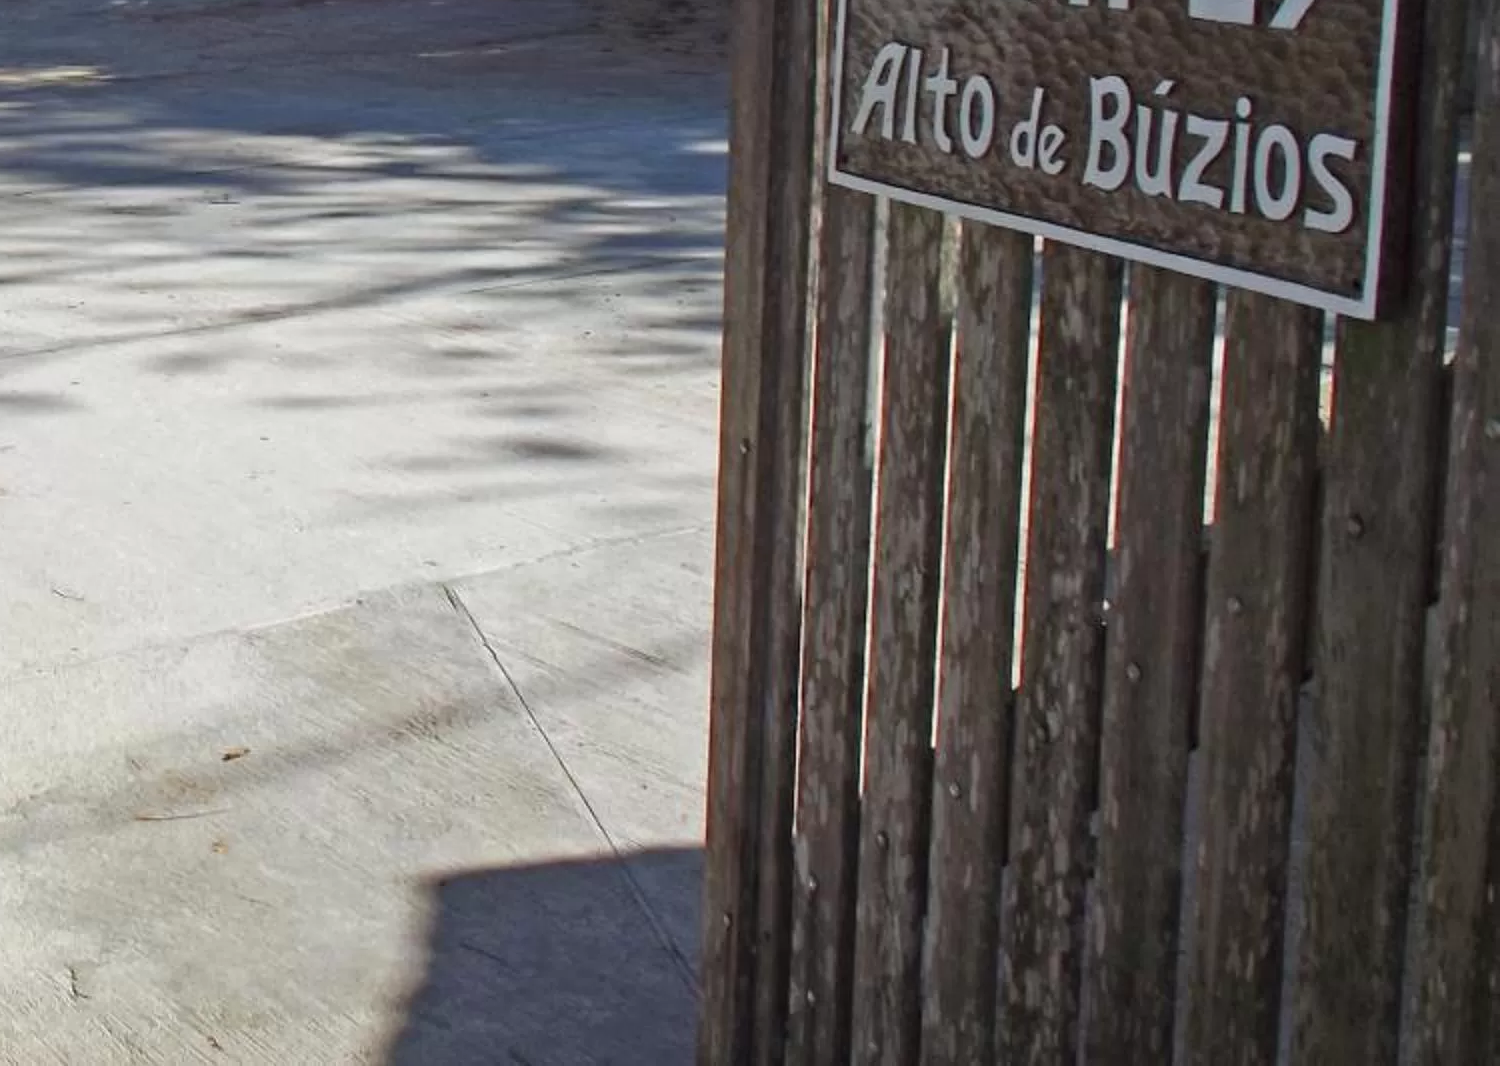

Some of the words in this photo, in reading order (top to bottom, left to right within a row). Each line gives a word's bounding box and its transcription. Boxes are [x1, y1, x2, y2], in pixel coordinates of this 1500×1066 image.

[851, 42, 995, 158] Alto
[1010, 87, 1066, 174] de
[1083, 75, 1357, 233] Búzios
